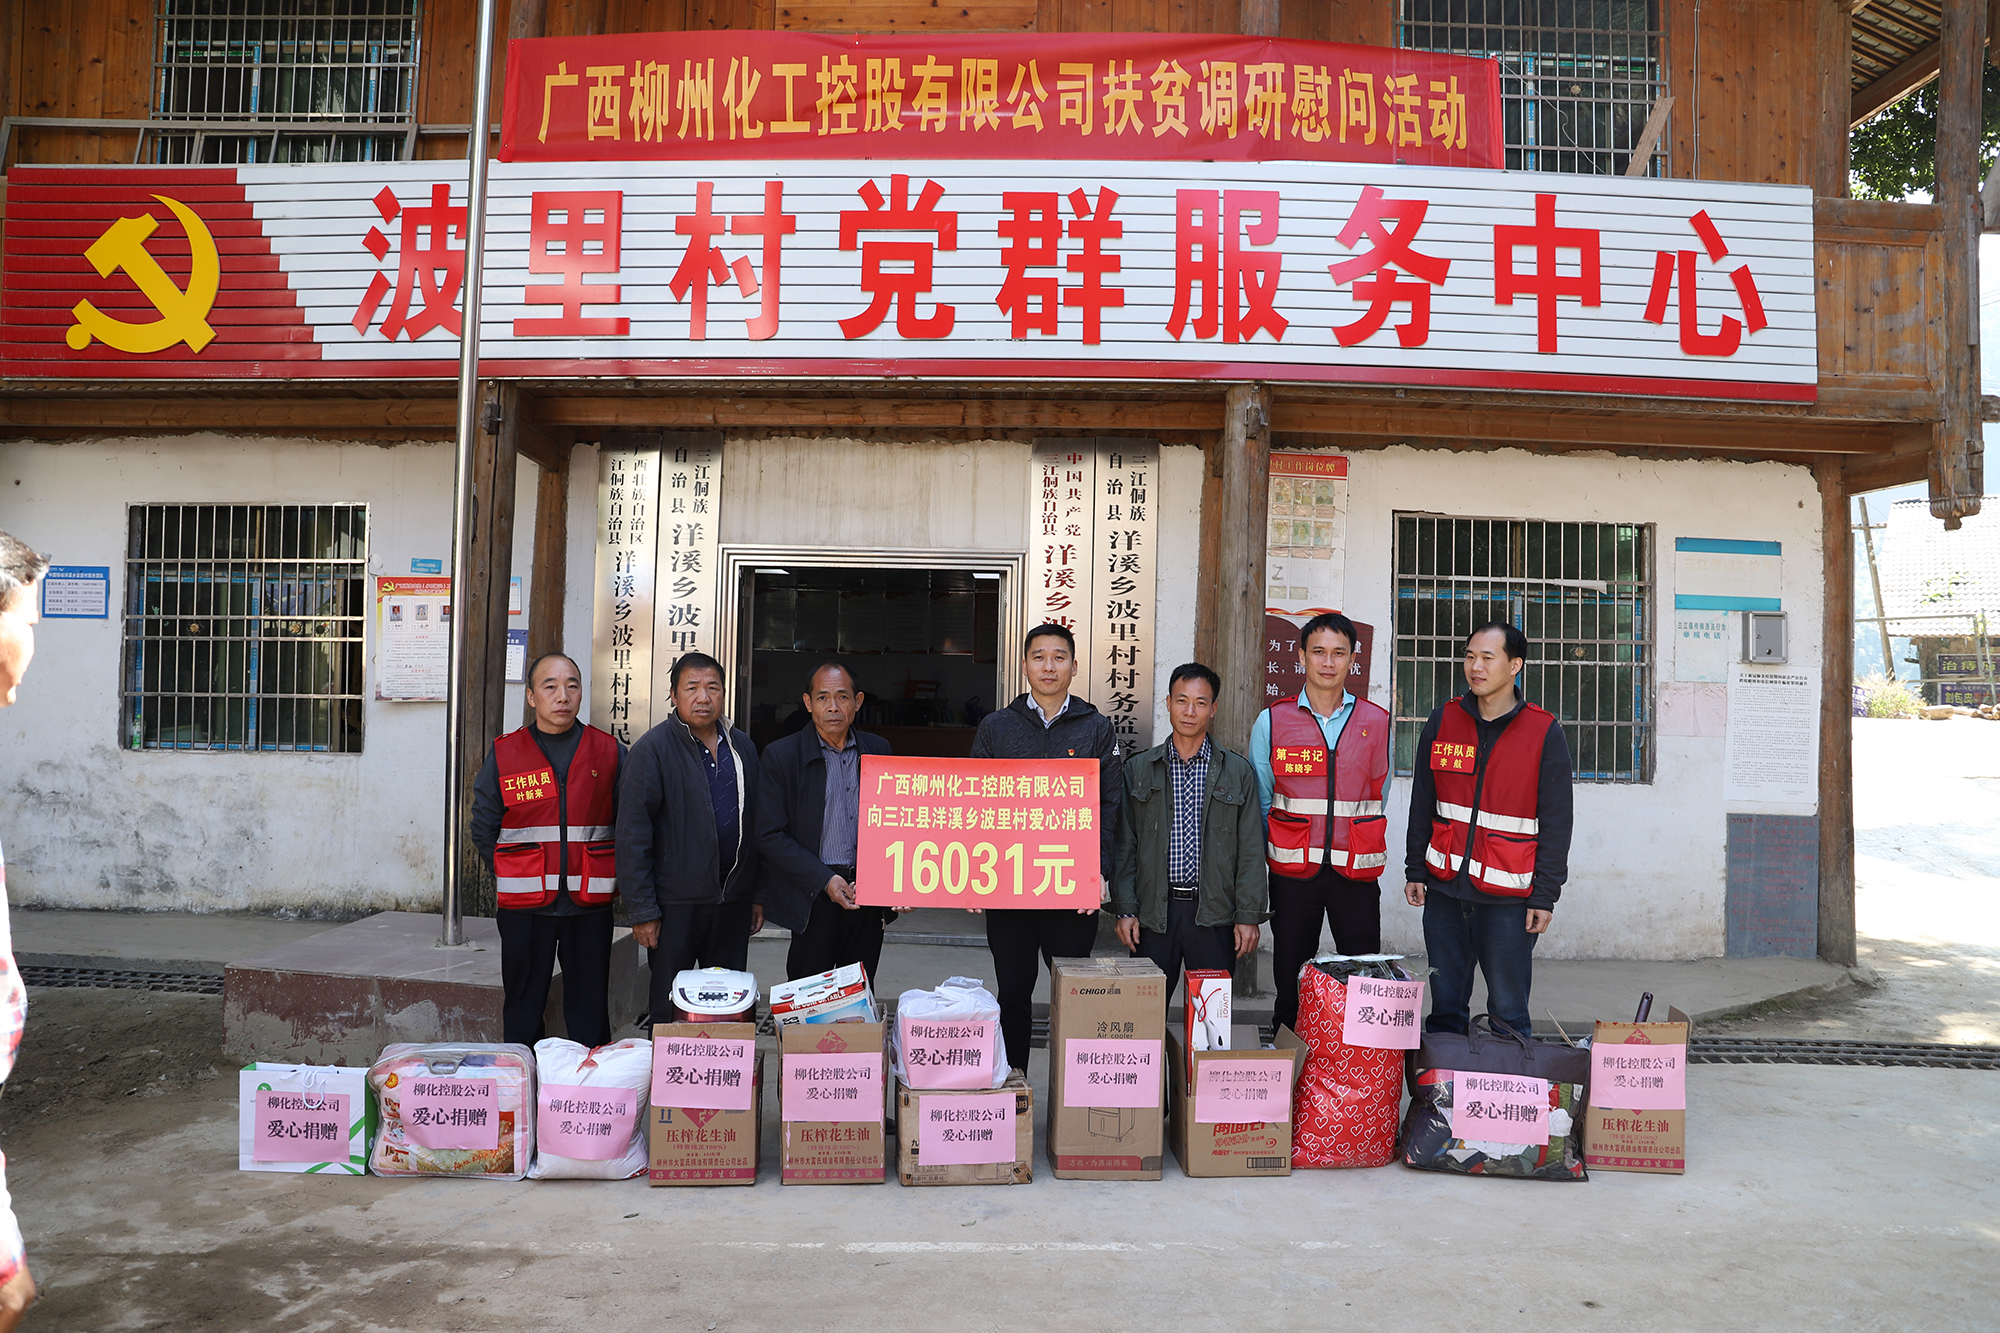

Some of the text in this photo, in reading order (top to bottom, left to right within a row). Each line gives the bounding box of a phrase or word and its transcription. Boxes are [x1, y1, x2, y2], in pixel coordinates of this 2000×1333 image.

[538, 54, 1467, 150] 广西柳州化工控股有限公司扶贫调研慰问活动
[351, 175, 1768, 356] 波里村党群服务中心
[1041, 452, 1059, 536] 三江侗族自治县
[1064, 452, 1083, 537] 中国共产党
[1105, 452, 1123, 521] 自治县
[1128, 454, 1147, 522] 三江侗族
[1276, 748, 1324, 763] 第一书记
[1433, 743, 1475, 759] 工作队员
[1284, 763, 1313, 774] 陈晓宇
[504, 771, 552, 791] 工作队员
[876, 772, 1085, 798] 广西柳州化工控股有限公司
[516, 788, 544, 801] 叶新来
[867, 804, 1093, 831] 向三江县洋溪乡波里村爱心消费
[885, 840, 1077, 896] 16031元
[1359, 982, 1418, 999] 柳化控股公司
[1357, 1006, 1415, 1028] 爱心捐赠
[910, 1024, 984, 1039] 柳化控股公司
[1097, 1021, 1134, 1033] 冷风扇
[667, 1042, 744, 1058] 柳化控股公司
[909, 1048, 982, 1067] 爱心捐赠
[1076, 1052, 1150, 1066] 柳化控股公司
[1602, 1056, 1676, 1070] 柳化控股公司
[665, 1066, 741, 1087] 爱心捐赠
[794, 1067, 871, 1081] 柳化控股公司
[1087, 1072, 1138, 1085] 爱心捐赠
[1208, 1070, 1282, 1083] 柳化控股公司
[1614, 1075, 1664, 1088] 爱心捐赠
[413, 1083, 489, 1098] 柳化控股公司
[806, 1087, 858, 1100] 爱心捐赠
[1465, 1077, 1539, 1095] 柳化控股公司
[1218, 1088, 1268, 1101] 爱心捐赠
[267, 1096, 340, 1112] 柳化控股公司
[549, 1098, 627, 1116] 柳化控股公司
[1466, 1101, 1539, 1123] 爱心捐赠
[412, 1107, 488, 1127] 爱心捐赠
[930, 1108, 1005, 1121] 柳化控股公司
[267, 1119, 339, 1141] 爱心捐赠
[560, 1121, 612, 1136] 爱心捐赠
[1602, 1118, 1669, 1132] 压榨花生油
[666, 1129, 736, 1143] 压榨花生油
[800, 1127, 870, 1142] 压榨花生油
[942, 1129, 994, 1142] 爱心捐赠
